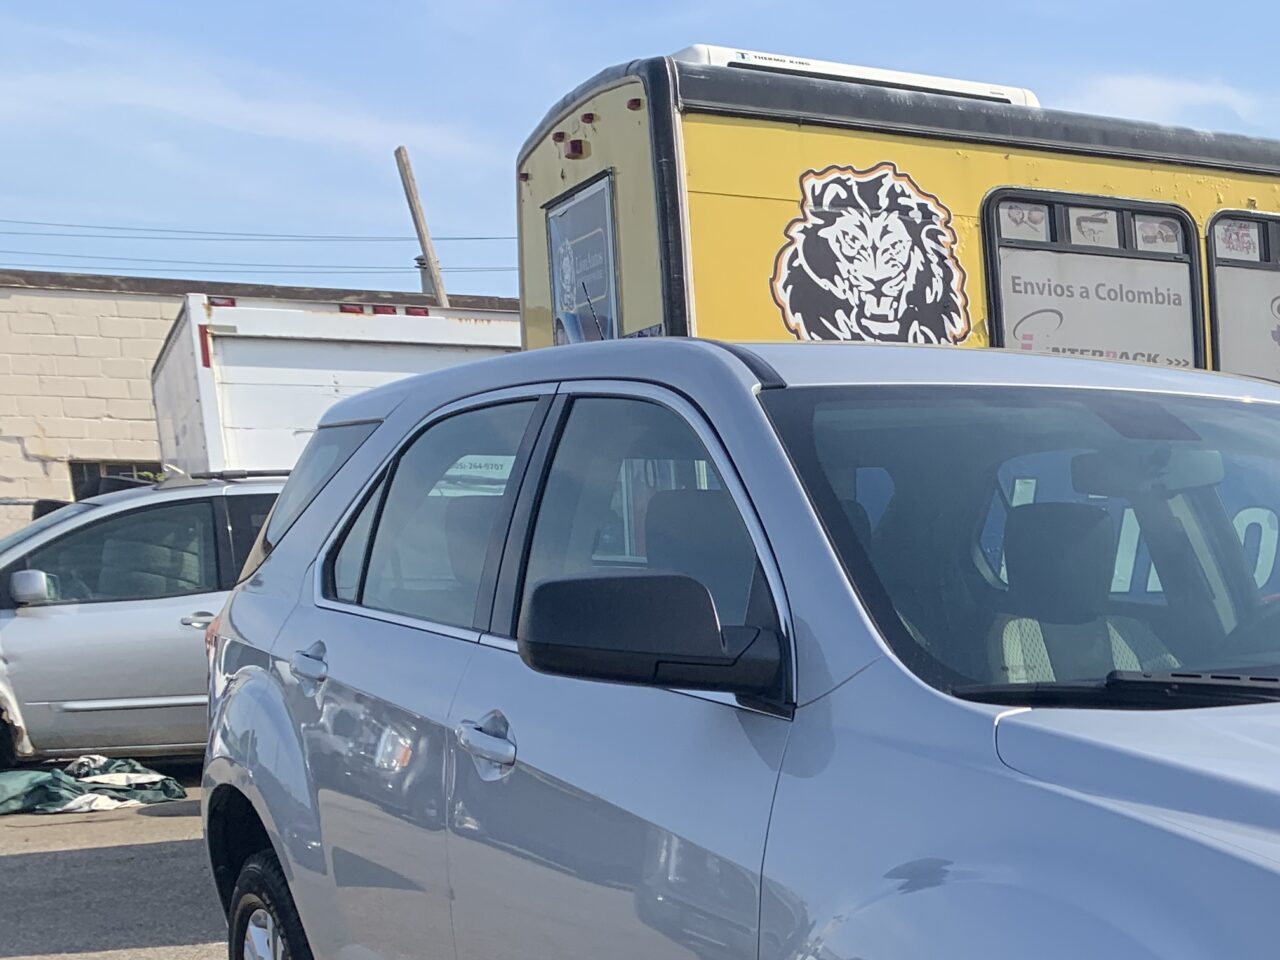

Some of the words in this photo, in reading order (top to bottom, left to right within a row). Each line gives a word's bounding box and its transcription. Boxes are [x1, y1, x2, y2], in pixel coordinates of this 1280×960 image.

[1010, 275, 1075, 299] Envios
[1079, 285, 1090, 300] a
[1095, 282, 1183, 307] Colombia
